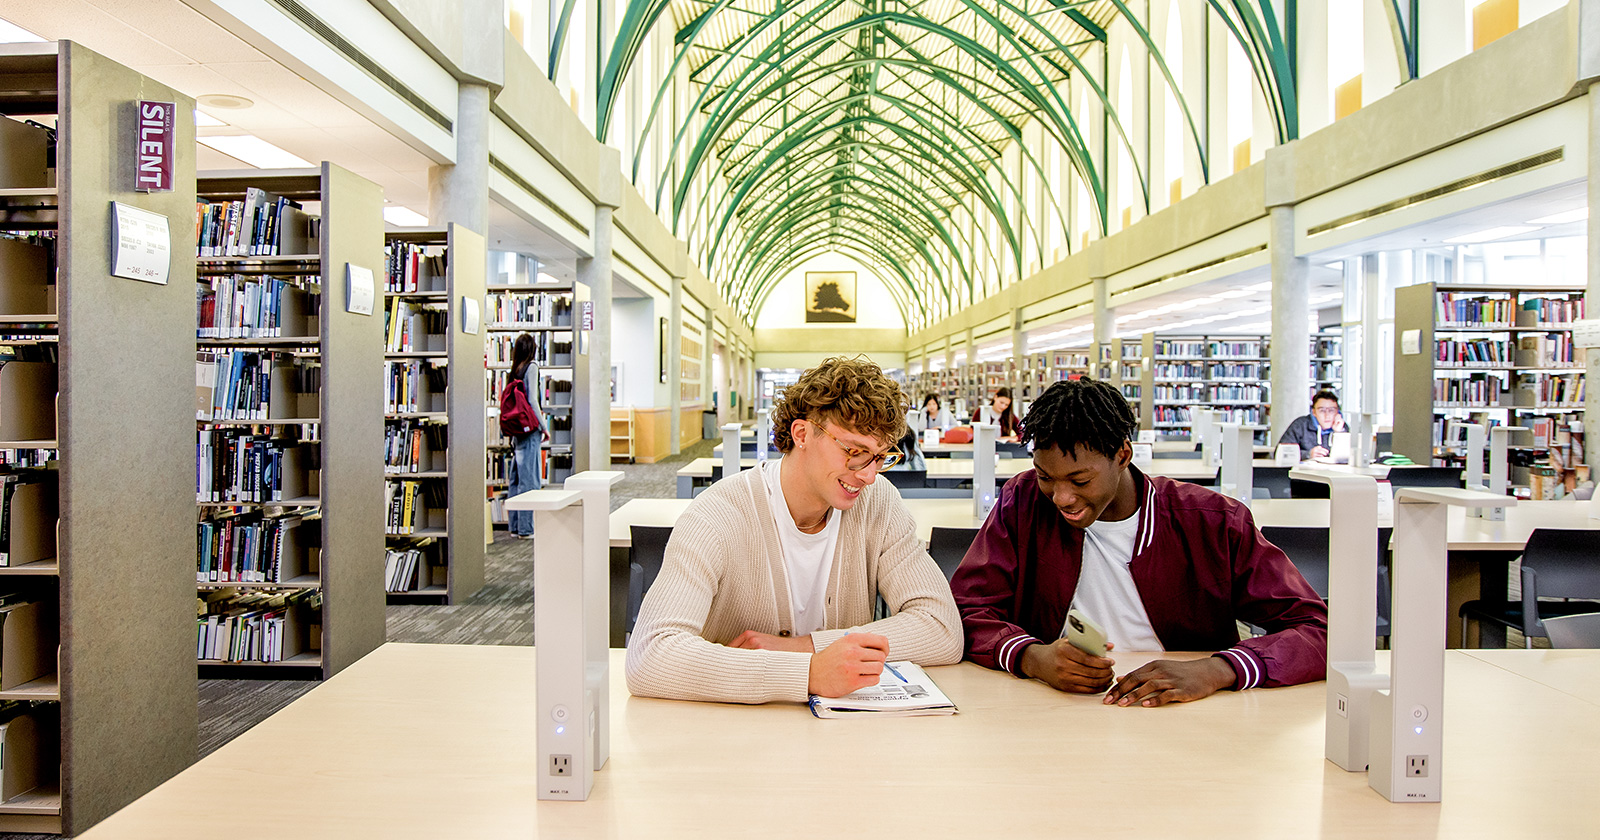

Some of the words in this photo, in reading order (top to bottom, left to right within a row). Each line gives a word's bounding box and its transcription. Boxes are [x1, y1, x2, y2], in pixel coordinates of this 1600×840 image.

[140, 103, 165, 187] SILENT
[230, 203, 239, 228] WASTE
[131, 266, 141, 275] 245
[583, 302, 591, 330] SILENT
